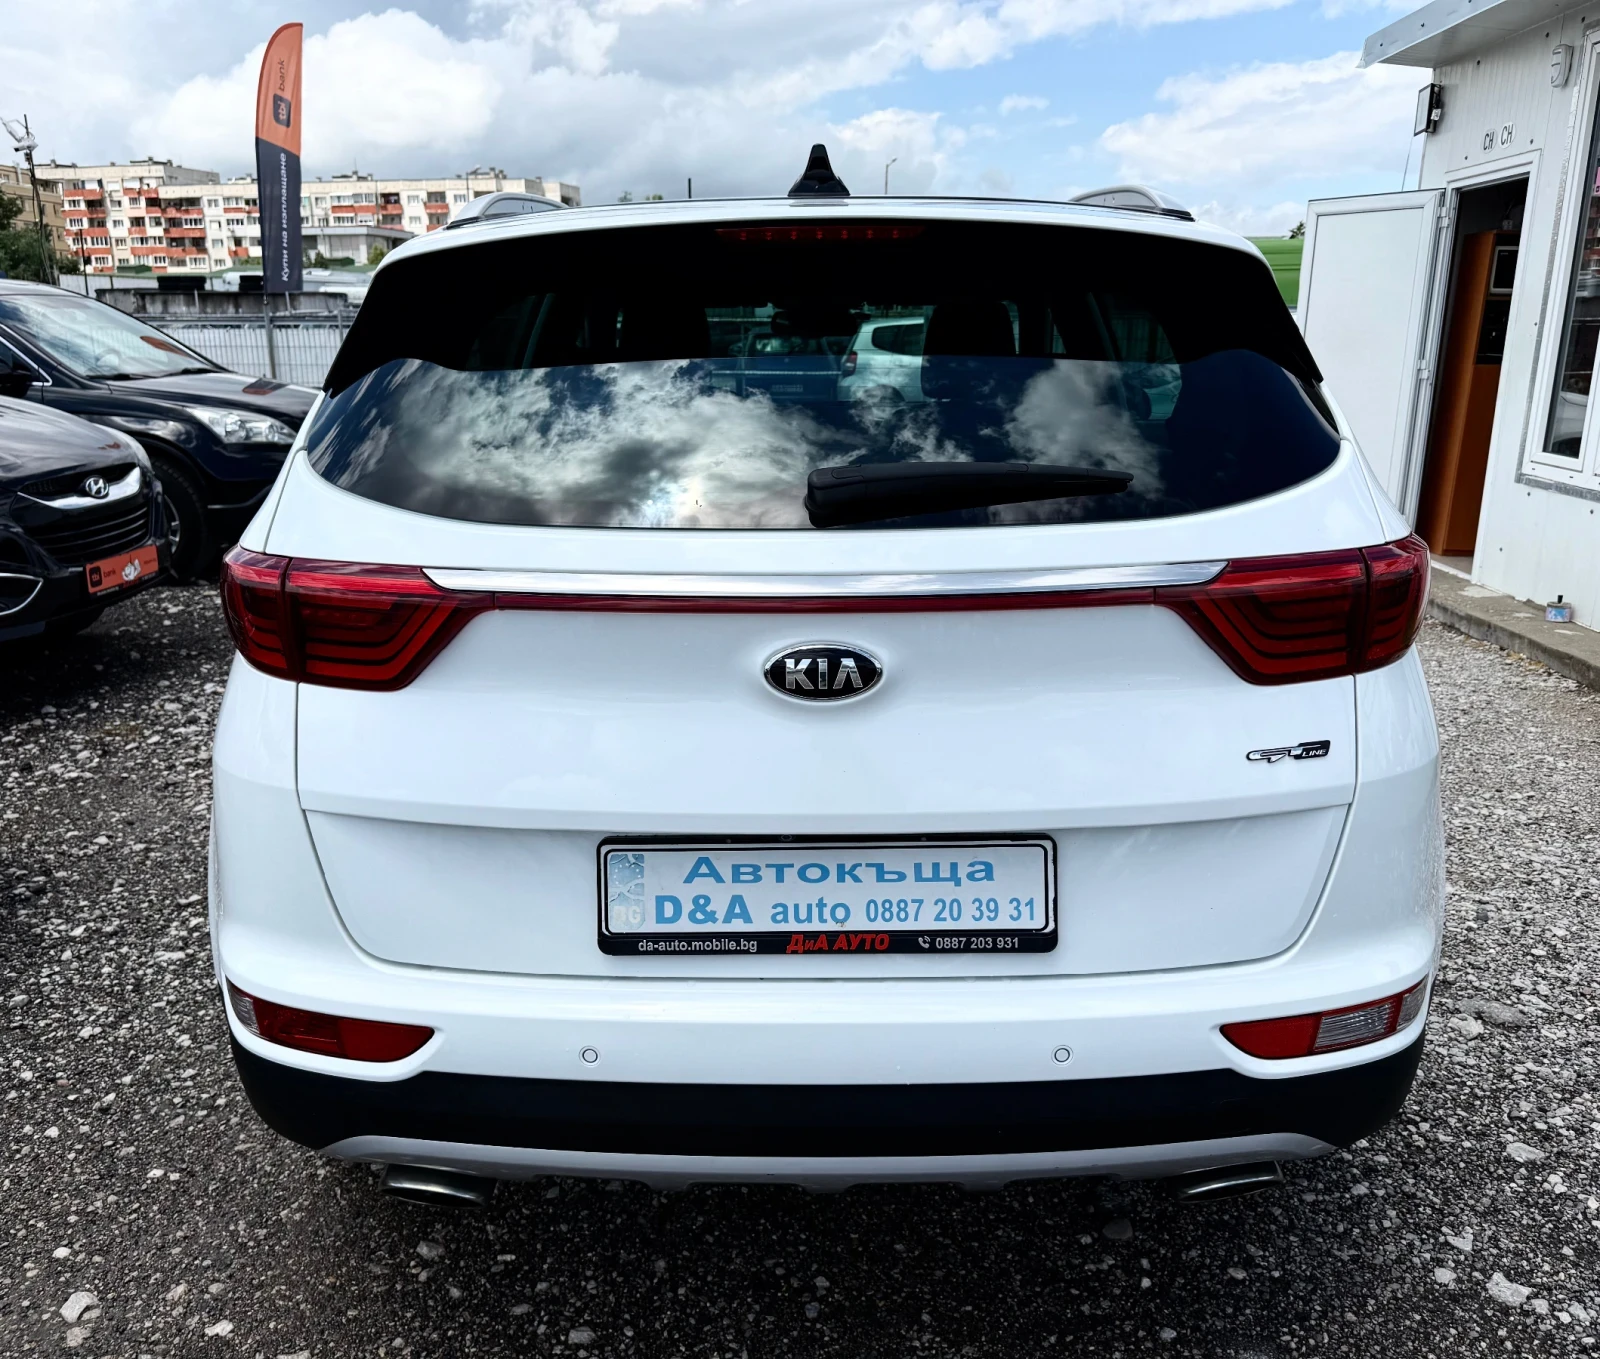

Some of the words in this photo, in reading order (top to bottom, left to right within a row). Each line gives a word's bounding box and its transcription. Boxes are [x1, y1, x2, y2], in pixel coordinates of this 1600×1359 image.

[278, 58, 286, 92] bank
[277, 100, 287, 121] tbi
[1483, 131, 1495, 151] CH
[1500, 123, 1514, 146] CH
[280, 152, 288, 229] изплащане
[282, 230, 288, 248] на
[281, 250, 290, 282] Купи
[103, 567, 117, 578] bank
[784, 657, 863, 690] KIA
[1301, 748, 1328, 758] LINE
[682, 856, 996, 887] Автокъща
[654, 893, 754, 925] D&A
[770, 896, 851, 925] auto
[865, 898, 925, 924] 0887
[933, 898, 963, 923] 20
[971, 897, 1000, 922] 39
[1008, 897, 1035, 922] 31
[638, 939, 758, 953] da-auto.mobile.bg
[786, 933, 829, 955] ДиА
[832, 933, 890, 951] АУТО
[935, 937, 967, 950] 0887
[970, 937, 993, 949] 203
[996, 936, 1020, 949] 931
